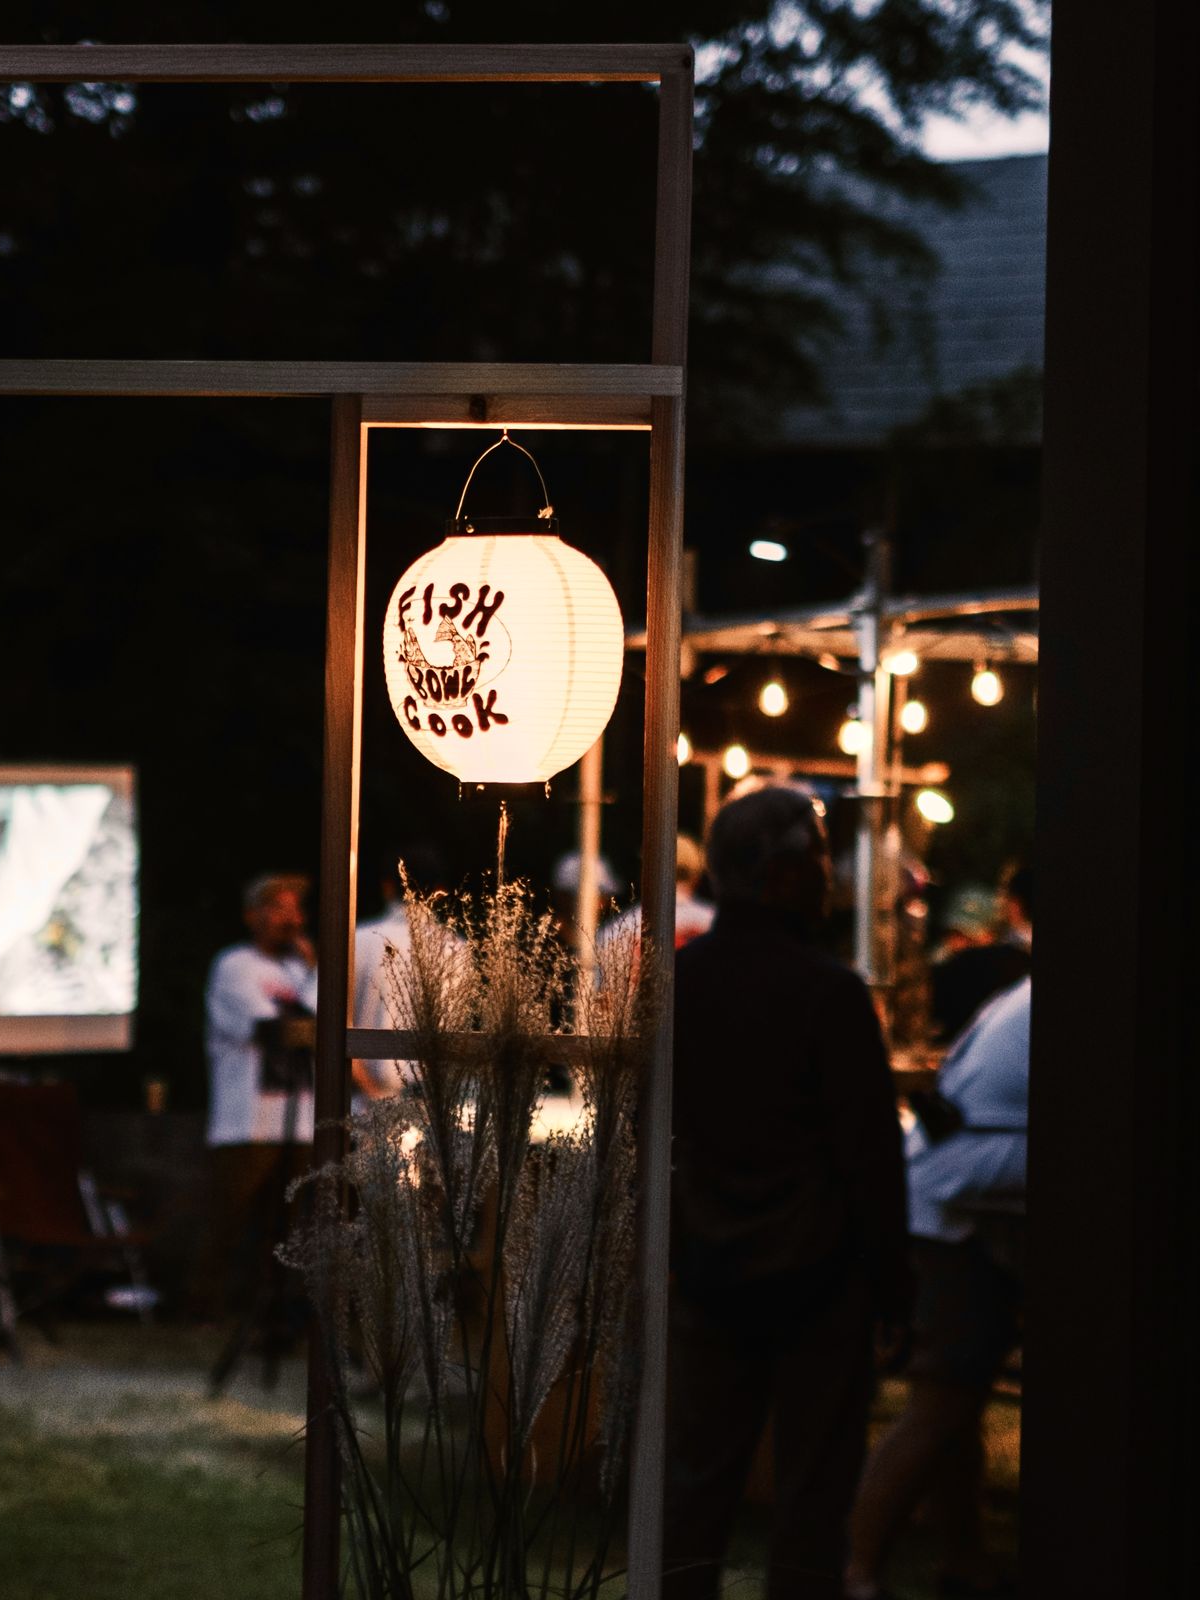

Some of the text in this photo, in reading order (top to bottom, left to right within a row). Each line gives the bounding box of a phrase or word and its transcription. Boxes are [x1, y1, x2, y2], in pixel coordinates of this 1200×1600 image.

[398, 583, 504, 637] FISH
[408, 664, 475, 703] BOWL
[404, 690, 509, 738] COOK
